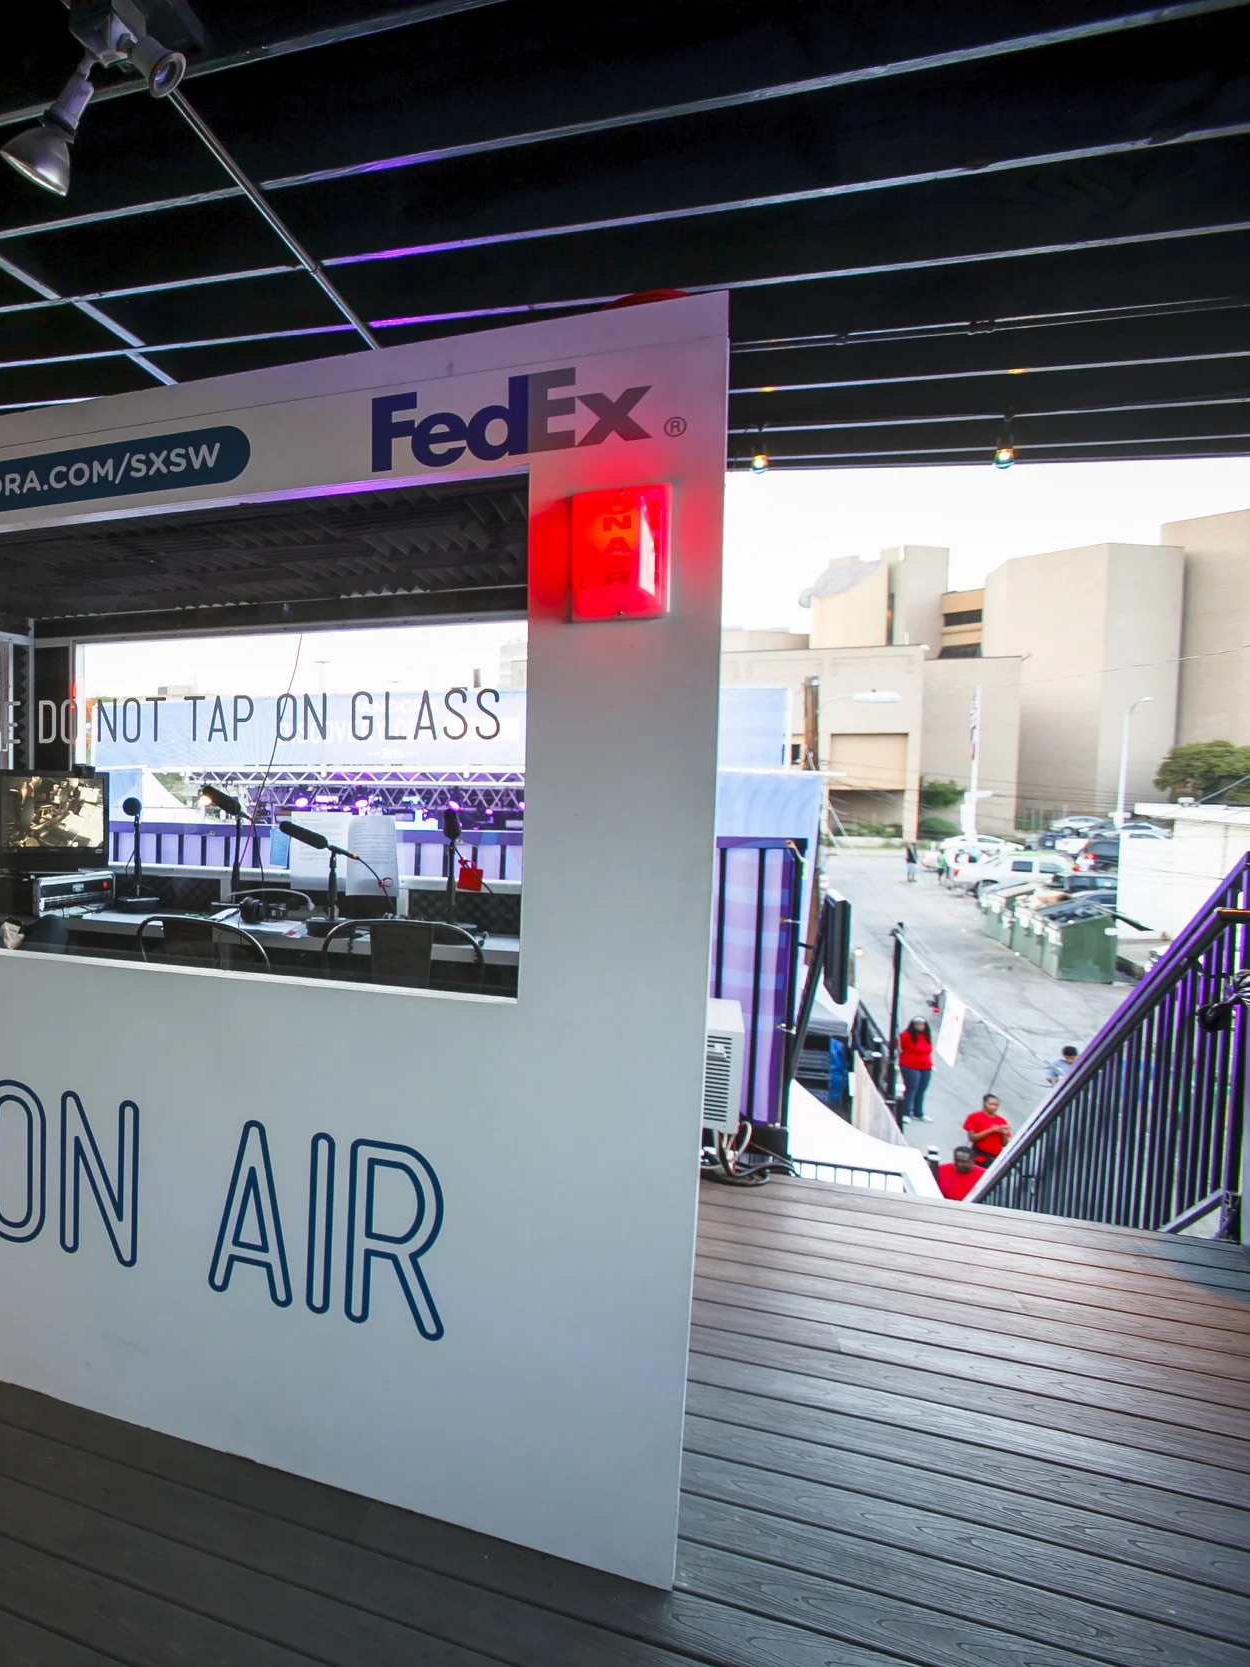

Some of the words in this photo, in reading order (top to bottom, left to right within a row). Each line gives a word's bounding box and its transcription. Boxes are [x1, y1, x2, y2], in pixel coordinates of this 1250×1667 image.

[371, 366, 653, 473] FedEx
[38, 698, 78, 744] DO
[97, 696, 166, 743] NOT
[184, 693, 255, 743] TAP
[276, 692, 327, 742] ON
[351, 687, 500, 741] GLASS
[206, 1118, 445, 1342] AIR
